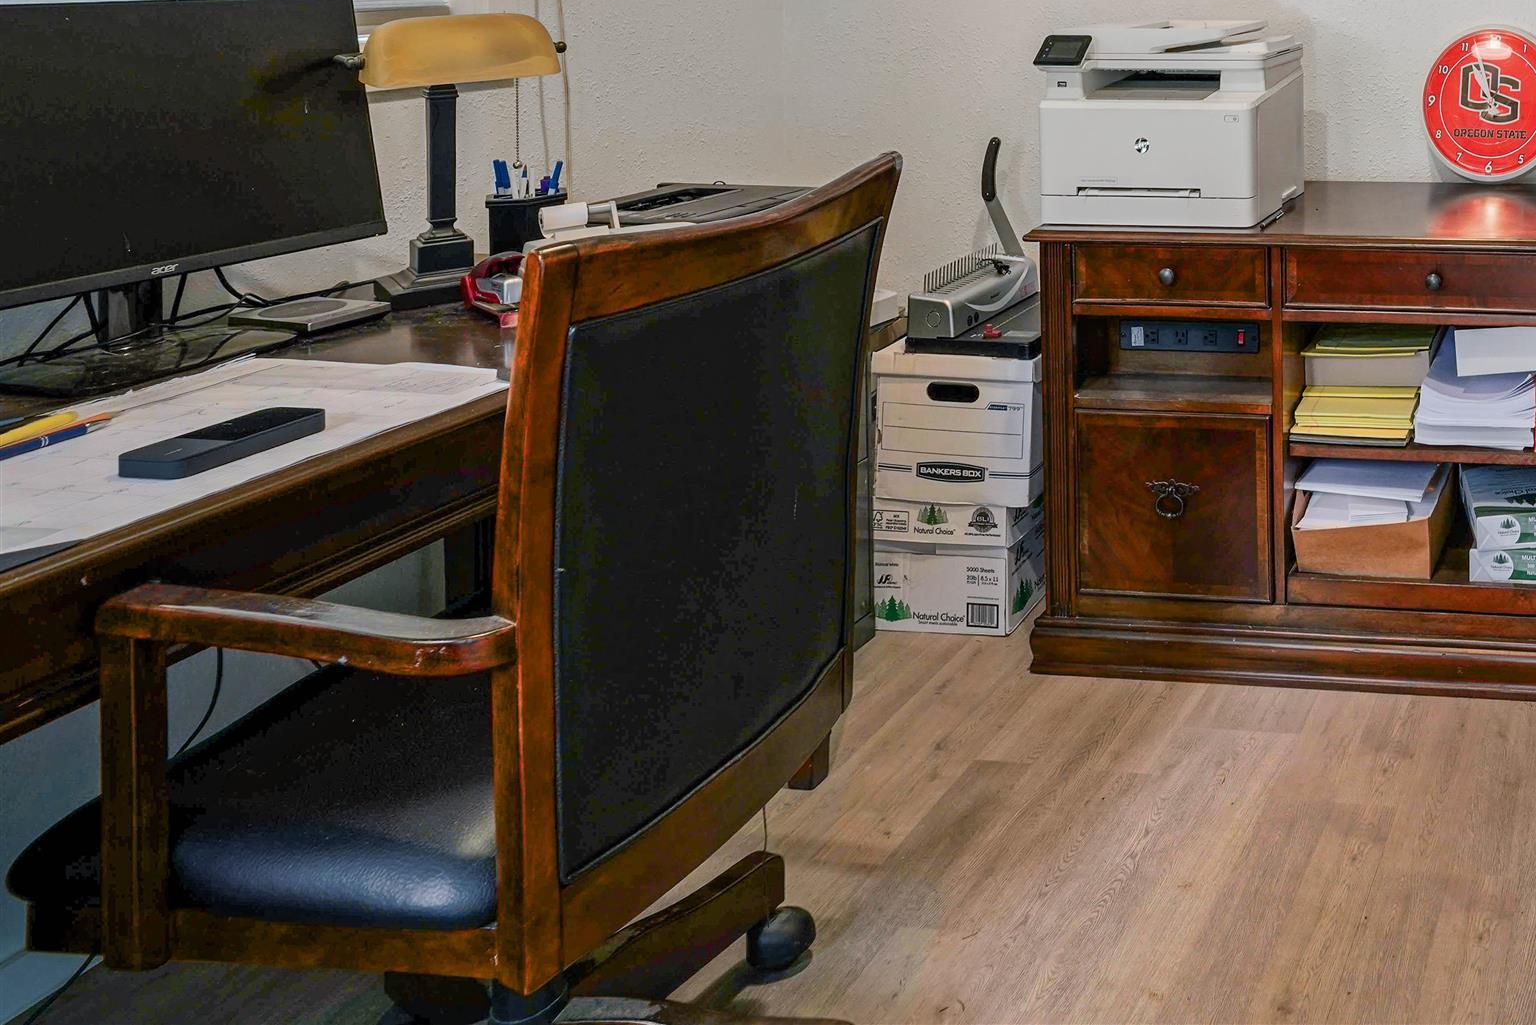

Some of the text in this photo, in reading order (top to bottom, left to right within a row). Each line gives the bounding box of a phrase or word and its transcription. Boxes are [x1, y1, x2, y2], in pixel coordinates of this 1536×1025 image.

[1438, 65, 1449, 74] 10
[1428, 95, 1436, 106] 9
[1435, 129, 1442, 139] 8
[1453, 128, 1527, 140] OREGON STATE
[1456, 152, 1462, 162] 7
[1518, 154, 1525, 164] 5
[1485, 161, 1492, 173] 6
[151, 263, 179, 275] acer
[920, 466, 982, 478] BANKERS BOX
[914, 526, 954, 536] Natural Choice
[913, 612, 939, 621] Natural
[940, 612, 964, 623] Choice
